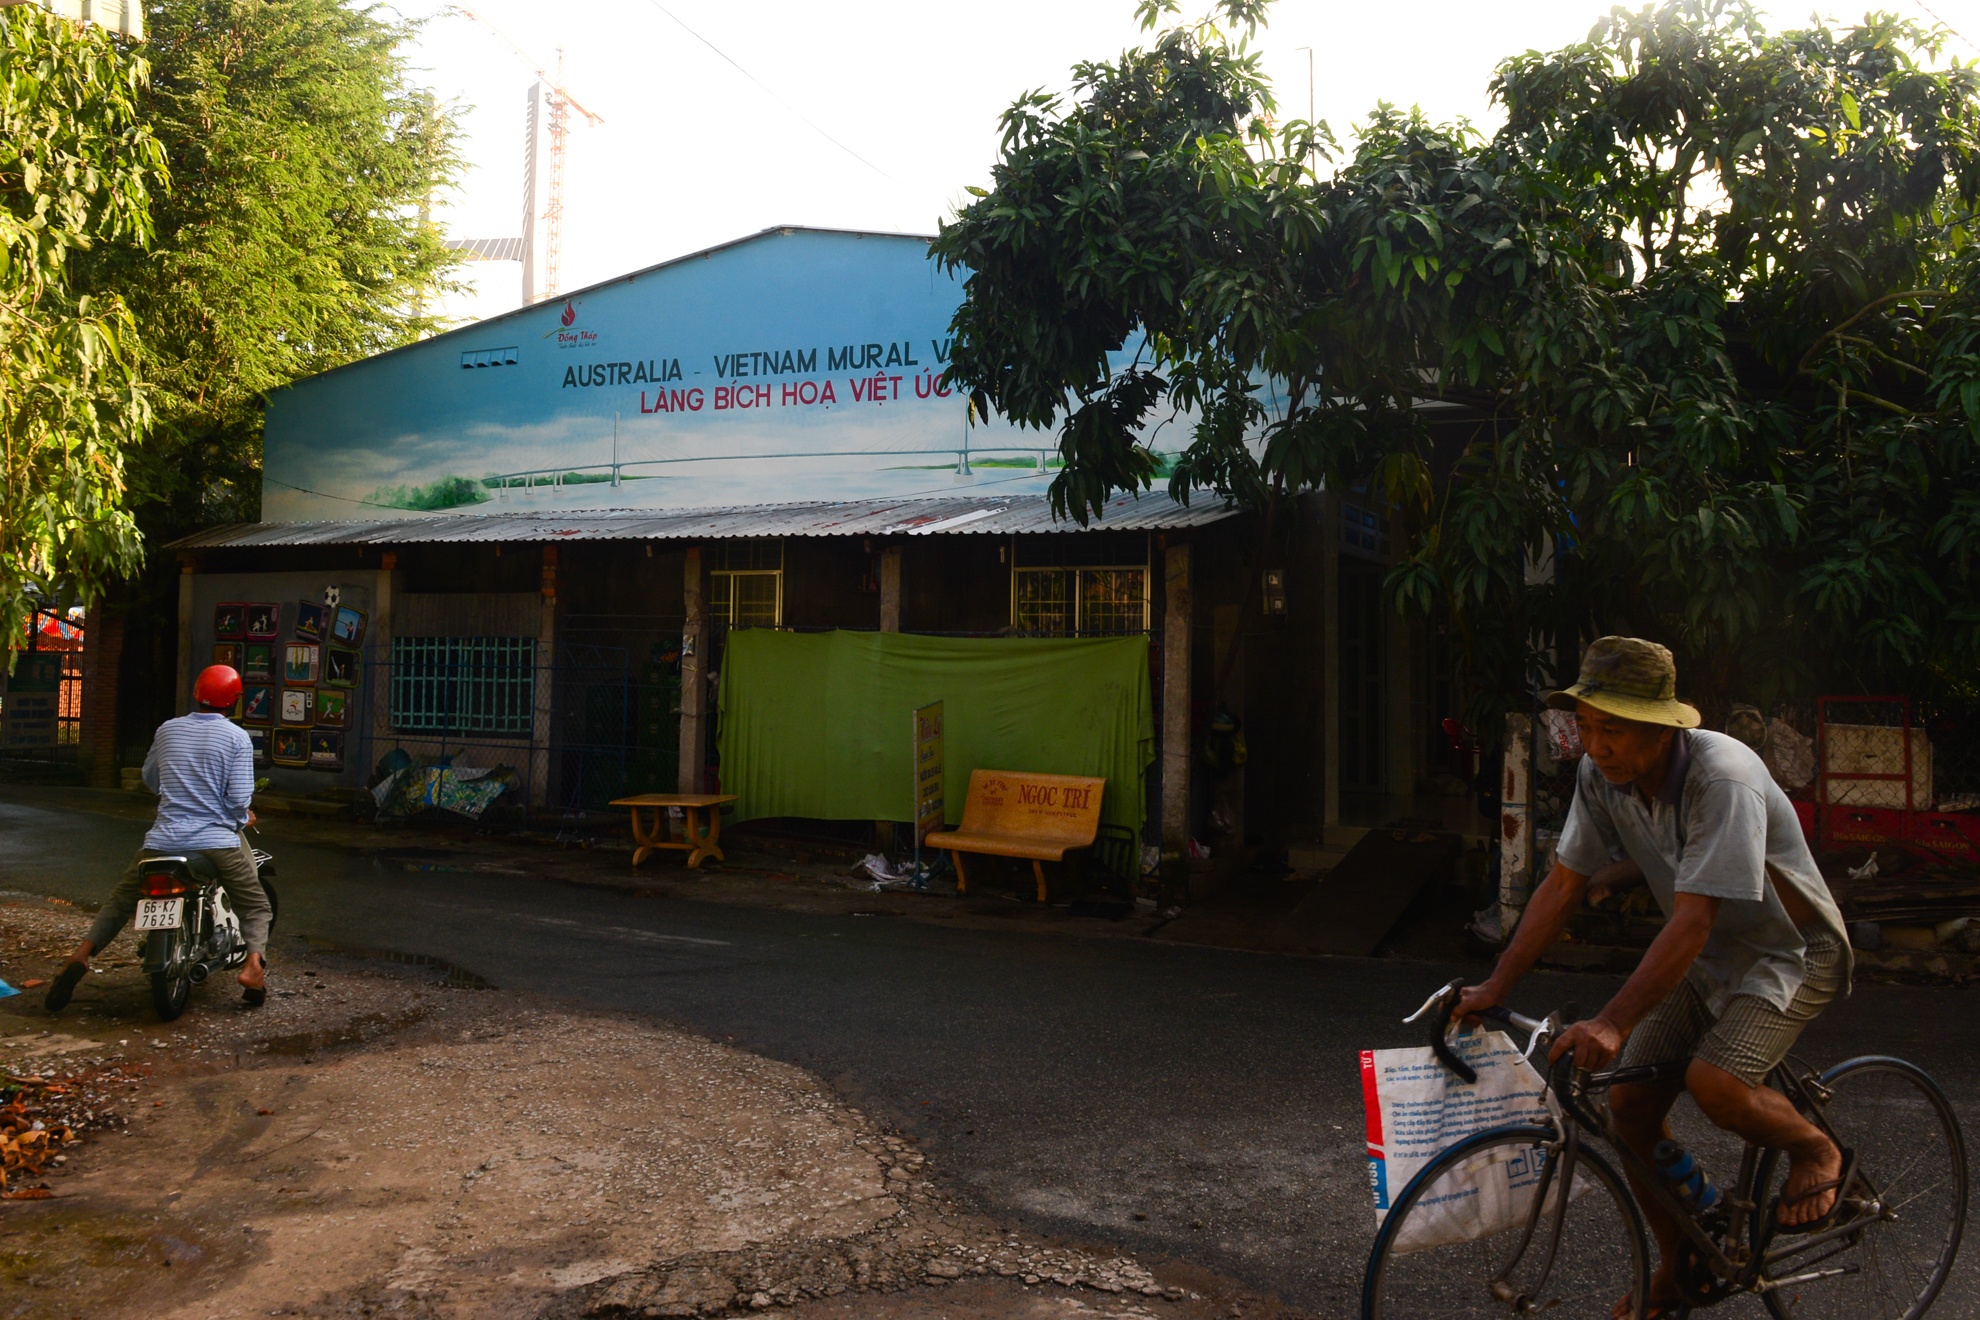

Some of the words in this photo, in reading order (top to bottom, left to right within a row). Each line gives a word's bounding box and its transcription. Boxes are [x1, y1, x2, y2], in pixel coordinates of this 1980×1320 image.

[562, 358, 683, 388] AUSTRALIA
[713, 348, 817, 378] VIETNAM
[828, 342, 918, 371] MURAL
[640, 386, 704, 414] LÀNG
[714, 379, 771, 410] BÍCH
[782, 380, 837, 409] HOẠ
[849, 370, 903, 406] VIỆT
[915, 367, 952, 398] ÚC
[1018, 784, 1058, 808] NGỌC
[1063, 784, 1092, 809] TRÍ
[144, 901, 176, 913] 66-K7
[142, 914, 175, 927] 7625
